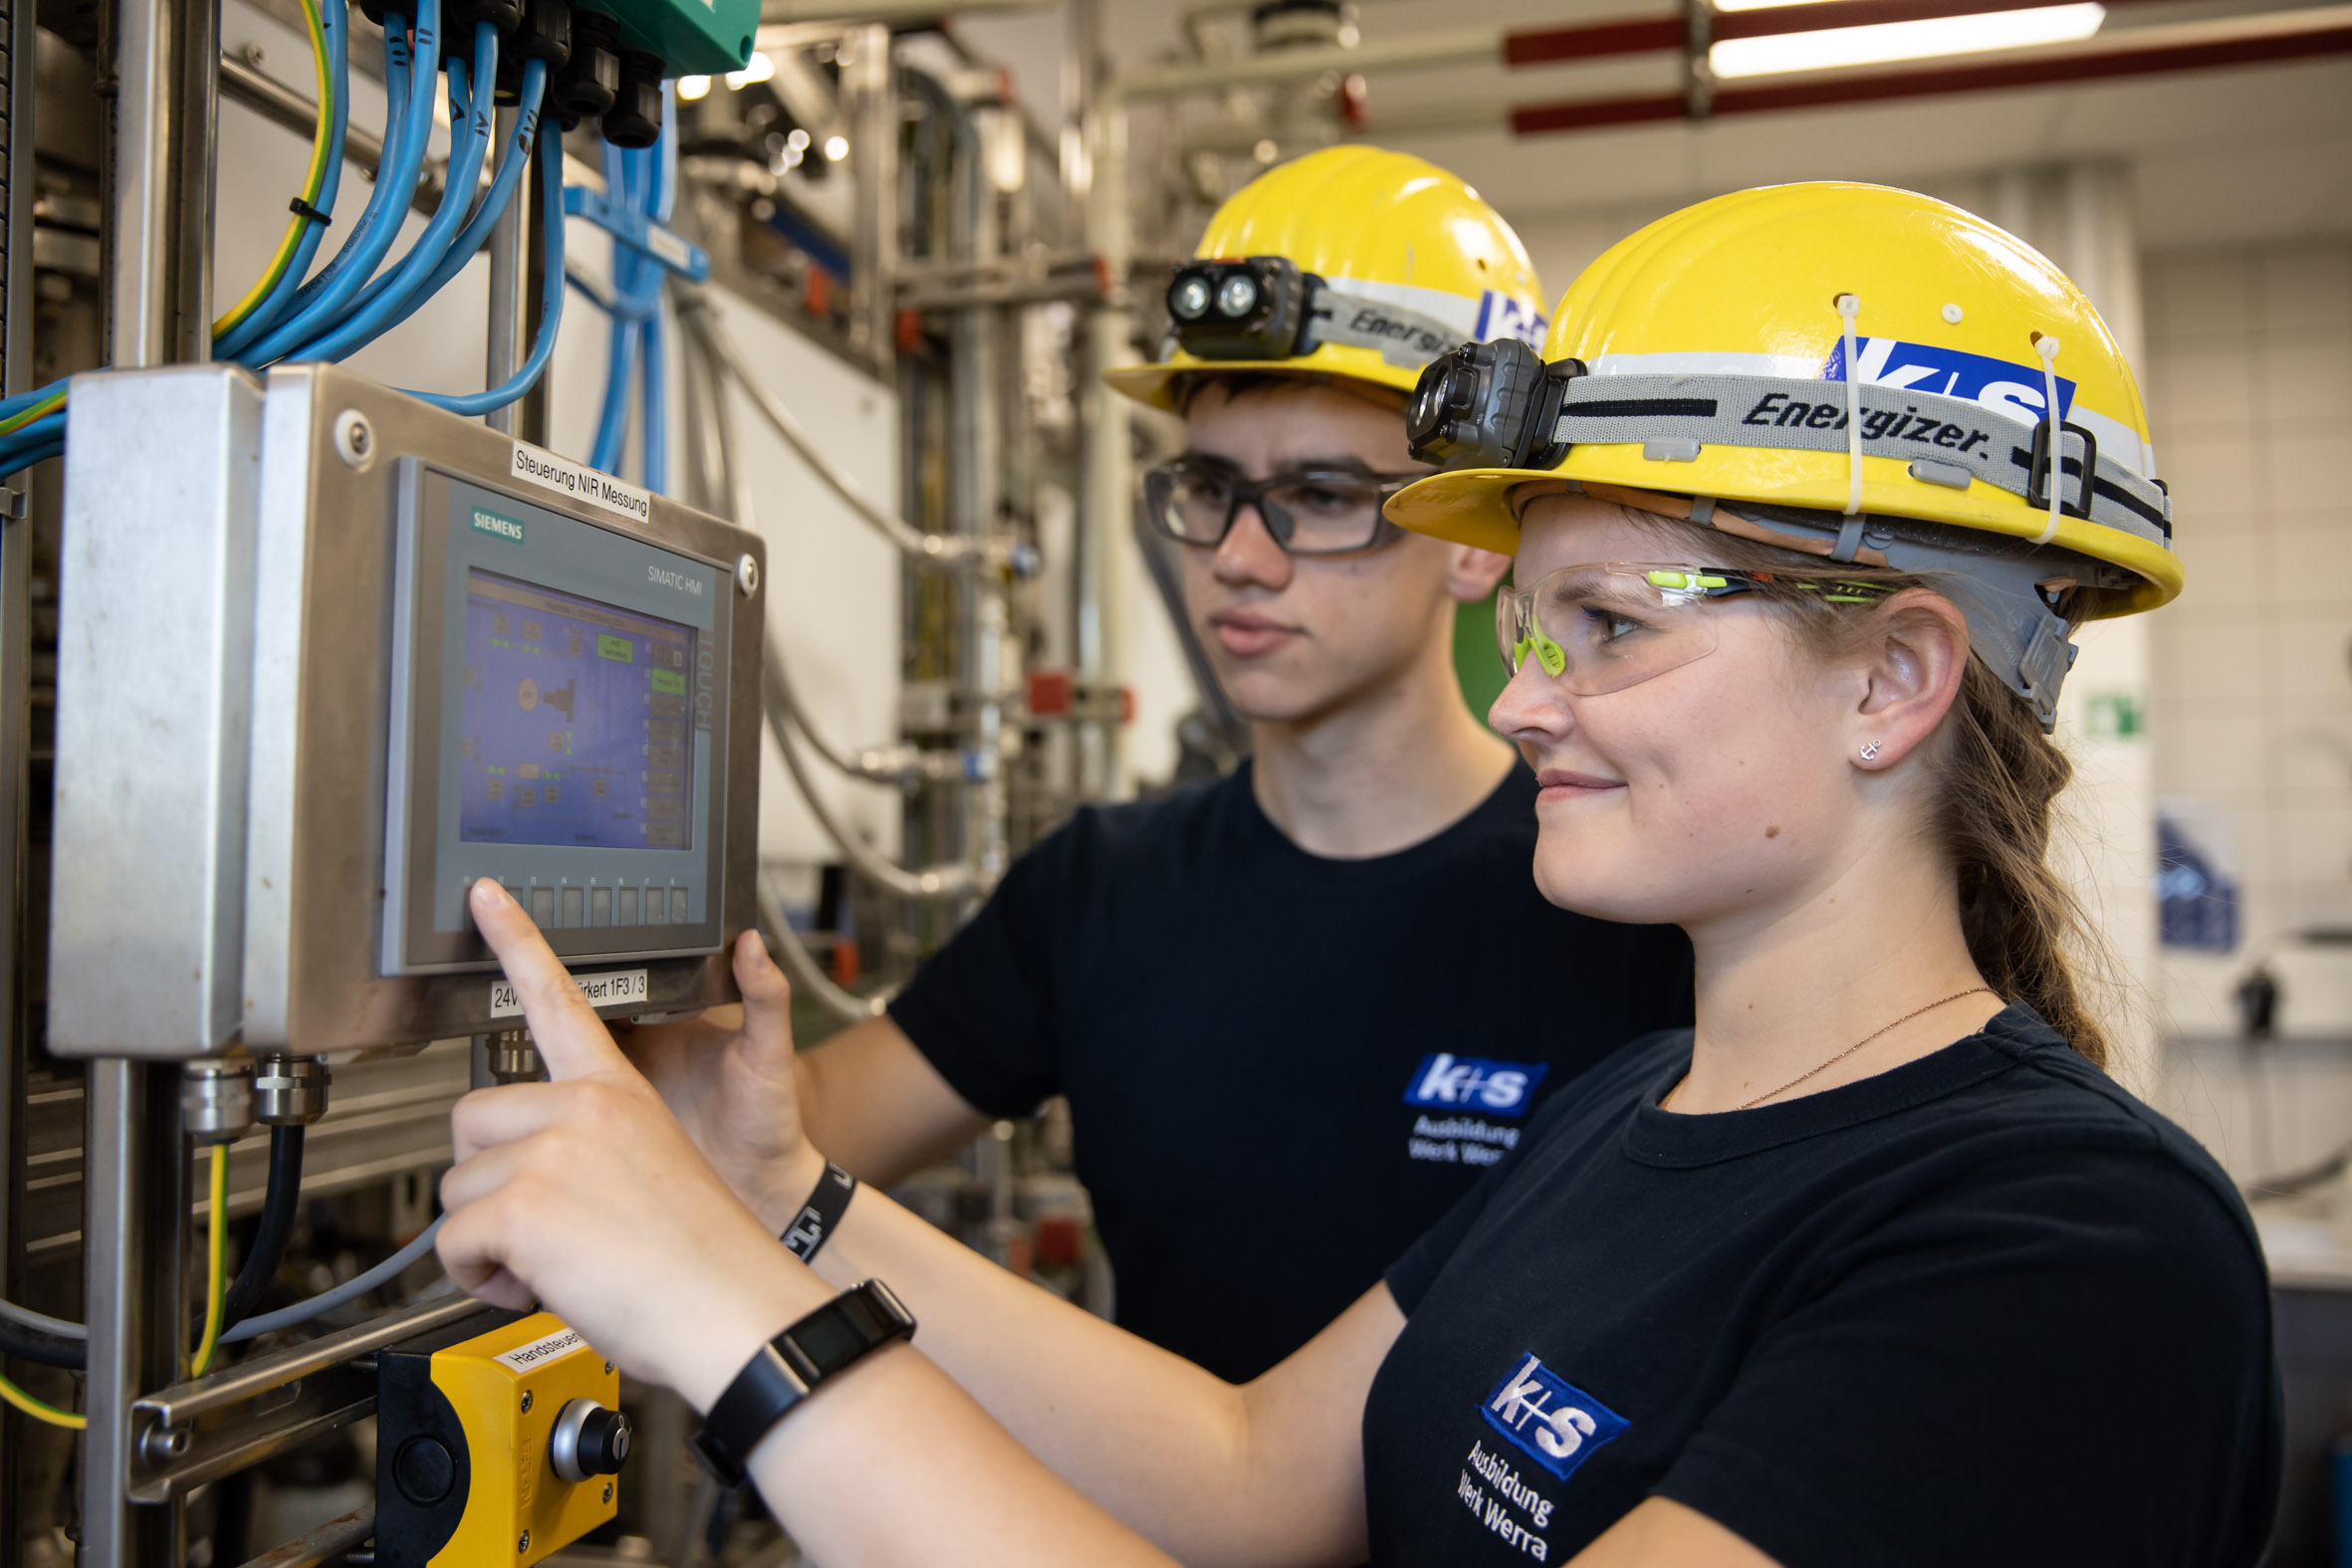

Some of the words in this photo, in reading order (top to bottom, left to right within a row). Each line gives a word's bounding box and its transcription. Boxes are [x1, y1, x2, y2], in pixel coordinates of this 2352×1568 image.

[516, 449, 576, 492] Steuerung
[578, 473, 599, 498] NIR
[601, 482, 648, 518] Messung
[473, 512, 524, 541] SIEMENS
[648, 565, 684, 590] SIMATIC
[684, 575, 703, 595] HMI
[698, 638, 714, 730] TOUCH
[610, 977, 630, 997] 1F3
[1408, 1137, 1459, 1164] Werk
[1412, 1114, 1522, 1151] Ausbildung
[1467, 1439, 1555, 1528] Ausbildung
[1457, 1467, 1485, 1518] Werk
[1484, 1496, 1548, 1563] Werra
